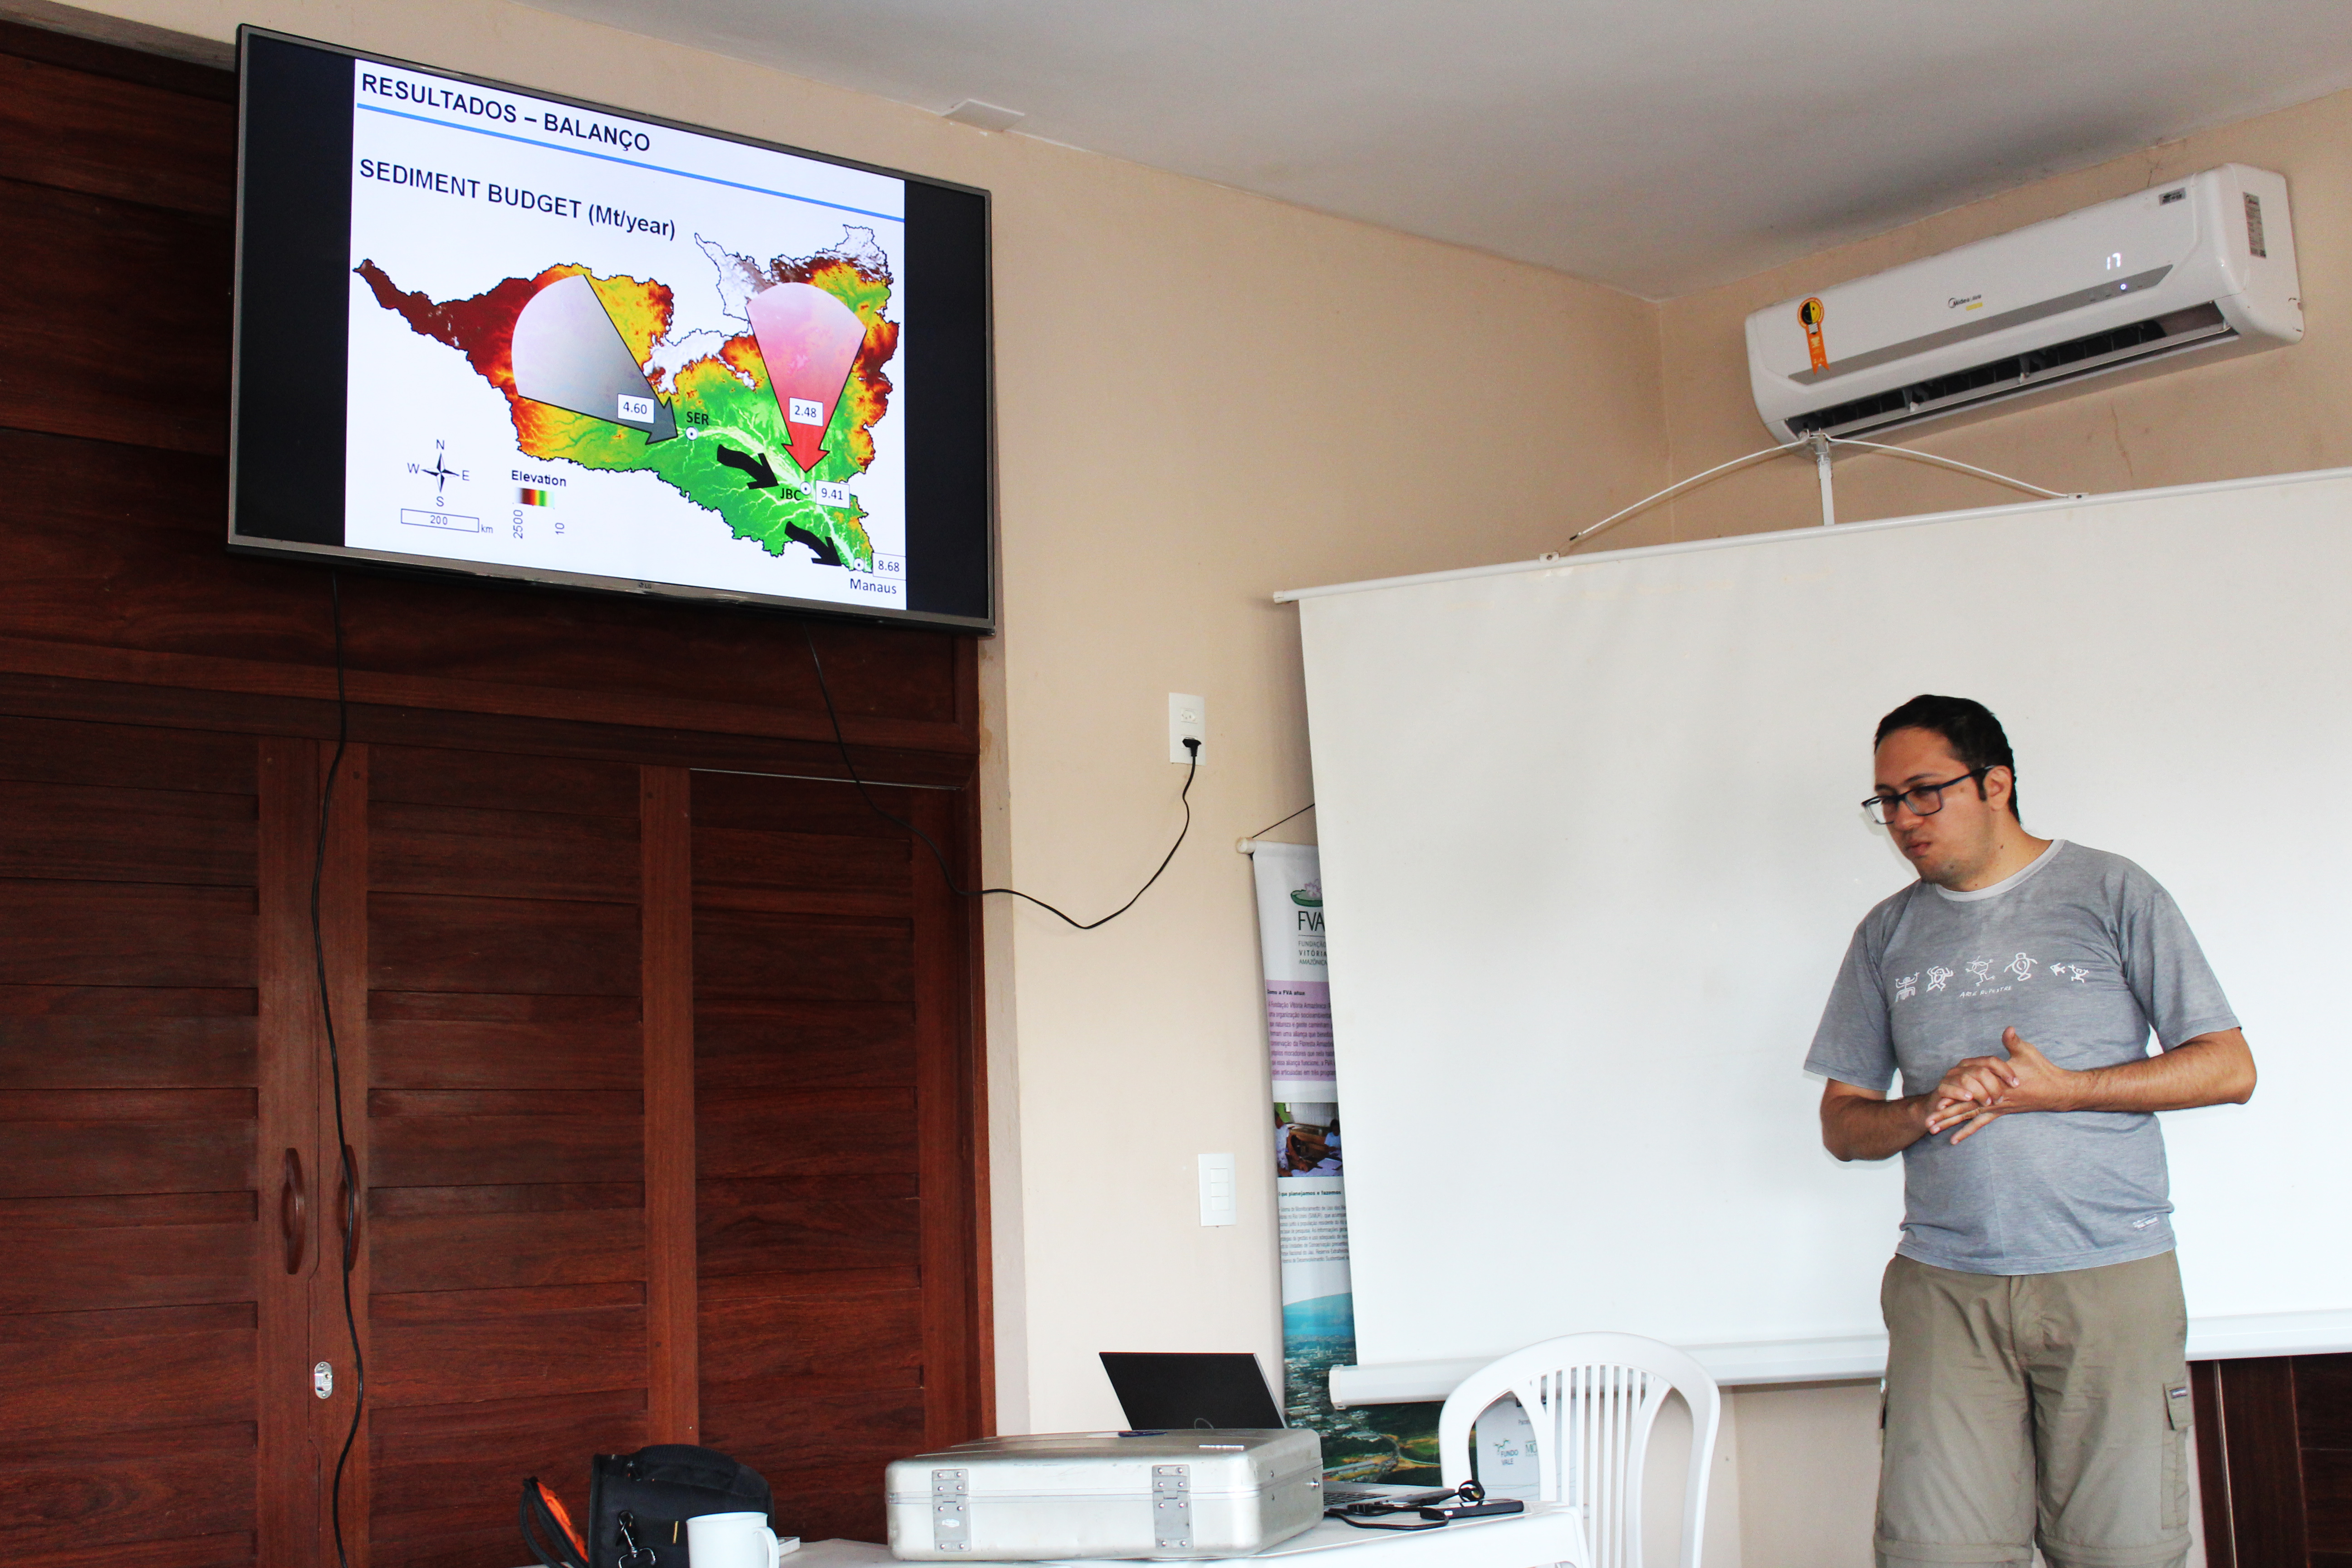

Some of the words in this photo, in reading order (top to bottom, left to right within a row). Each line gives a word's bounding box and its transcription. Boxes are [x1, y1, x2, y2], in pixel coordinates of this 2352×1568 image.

[363, 73, 517, 122] RESULTADOS
[544, 113, 650, 152] BALANÇO
[359, 159, 480, 199] SEDIMENT
[488, 183, 582, 219] BUDGET
[588, 204, 676, 241] (Mt/year)
[623, 402, 647, 414] 4.60
[794, 405, 817, 417] 2.48
[686, 411, 709, 425] SER
[436, 439, 445, 450] N
[407, 463, 420, 474] W
[462, 470, 470, 481] E
[511, 470, 567, 487] Elevation
[780, 488, 802, 500] JBC
[821, 488, 843, 500] 9.41
[436, 496, 445, 507] S
[430, 515, 448, 525] 200
[481, 524, 494, 534] km
[513, 510, 524, 539] 2500
[555, 522, 565, 535] 10
[878, 560, 900, 572] 8.68
[850, 578, 897, 594] Manaus
[1298, 911, 1325, 931] FVA
